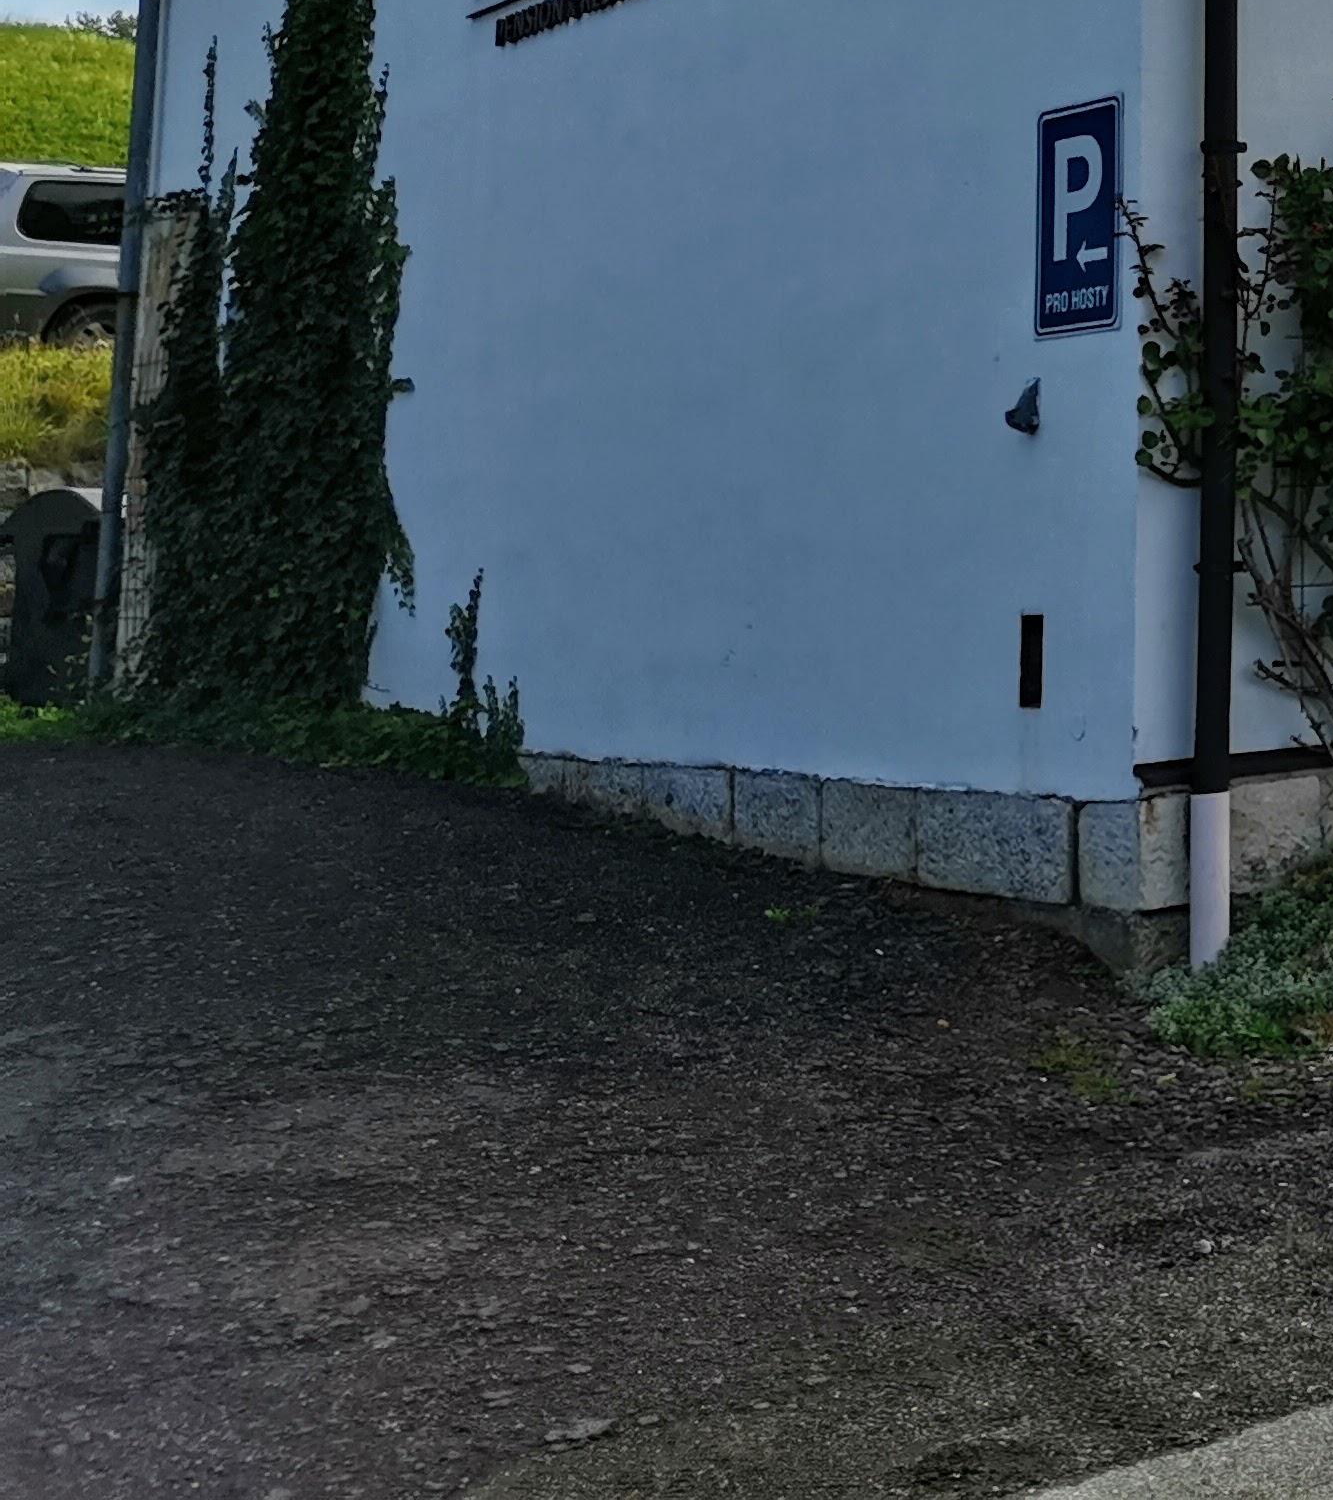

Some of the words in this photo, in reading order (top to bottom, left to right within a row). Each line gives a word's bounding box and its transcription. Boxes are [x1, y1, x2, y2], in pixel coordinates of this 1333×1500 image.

[1053, 134, 1103, 262] P
[1045, 290, 1069, 315] PRO
[1070, 285, 1108, 310] HOSTY
